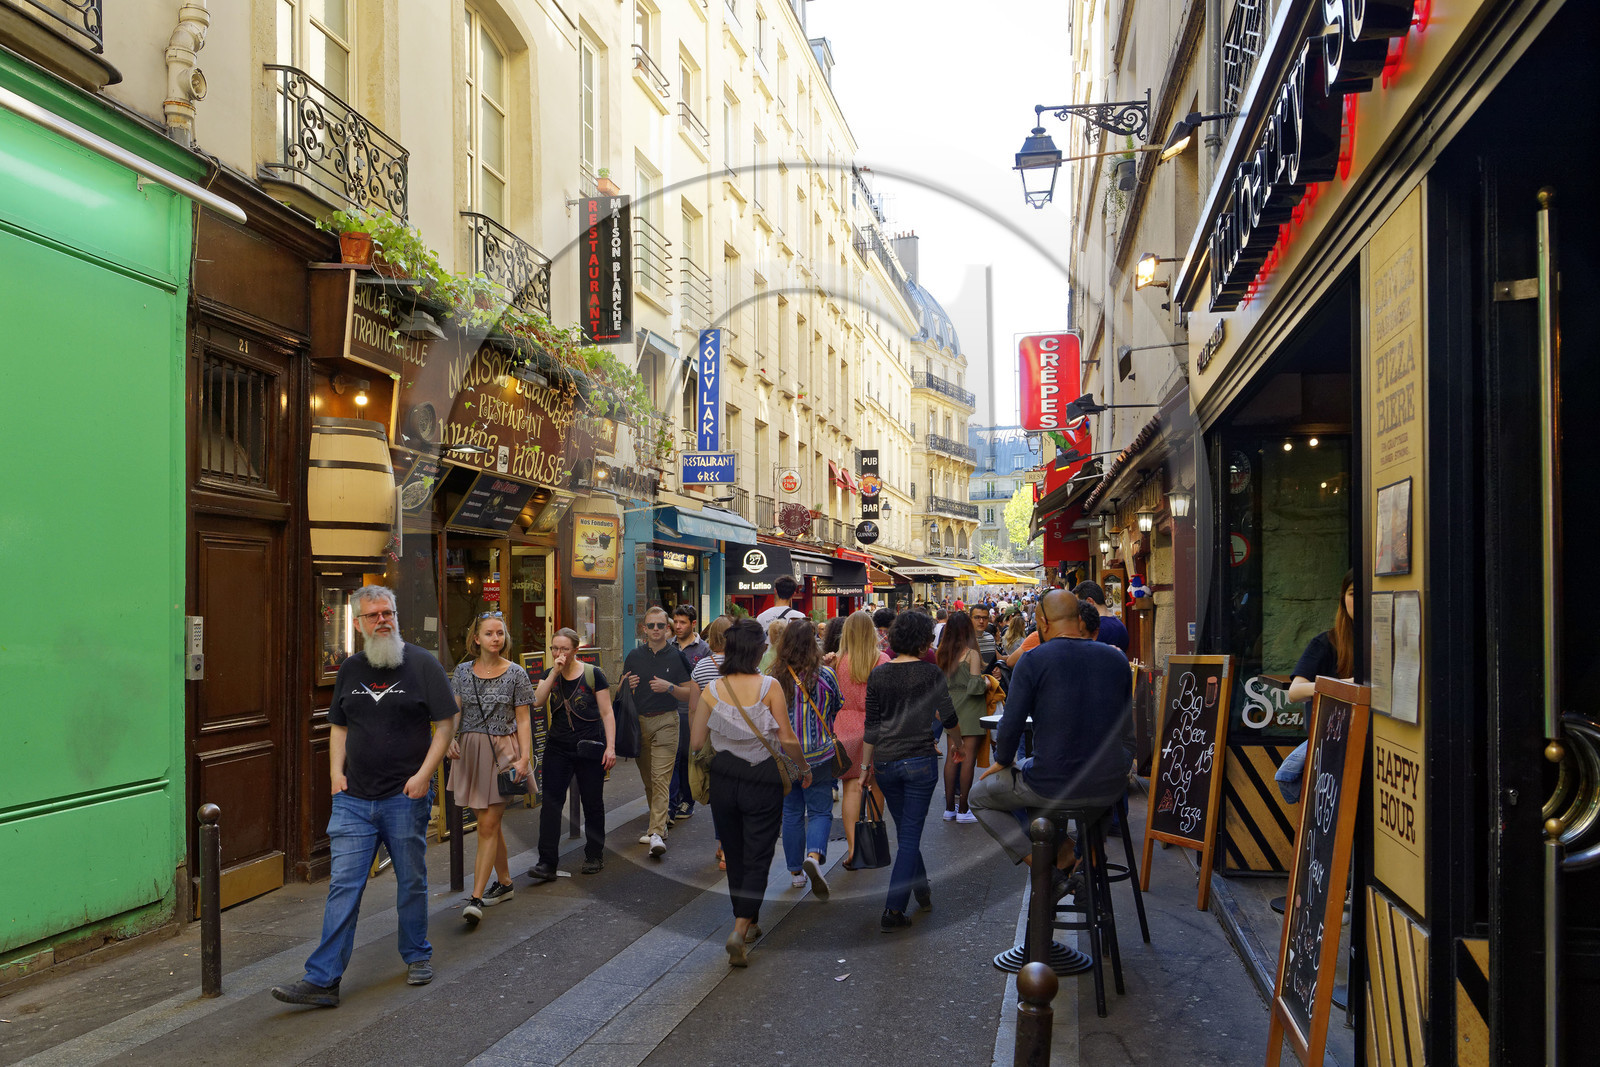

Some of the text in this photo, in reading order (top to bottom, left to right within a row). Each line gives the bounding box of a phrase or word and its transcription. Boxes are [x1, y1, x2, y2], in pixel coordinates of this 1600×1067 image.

[588, 200, 600, 332] RESTAURANT
[610, 198, 621, 331] MAISON BLANCHE
[238, 339, 249, 354] 21
[1375, 334, 1415, 394] PIZZA
[703, 331, 715, 450] SOUVLAKI
[1039, 338, 1060, 429] CRÊPES
[1376, 382, 1416, 437] BIERE
[683, 456, 734, 467] RESTAURANT
[697, 471, 720, 481] GREC
[862, 457, 877, 465] PUB
[591, 519, 614, 528] Fondues
[863, 503, 878, 512] BAR
[749, 557, 761, 565] 27
[739, 582, 772, 590] Bar Latino
[1172, 671, 1203, 720] Big
[1173, 710, 1206, 745] Beer
[1163, 745, 1192, 792] Big
[1376, 745, 1419, 800] HAPPY
[1172, 786, 1202, 833] Pizza
[1380, 788, 1416, 845] HOUR
